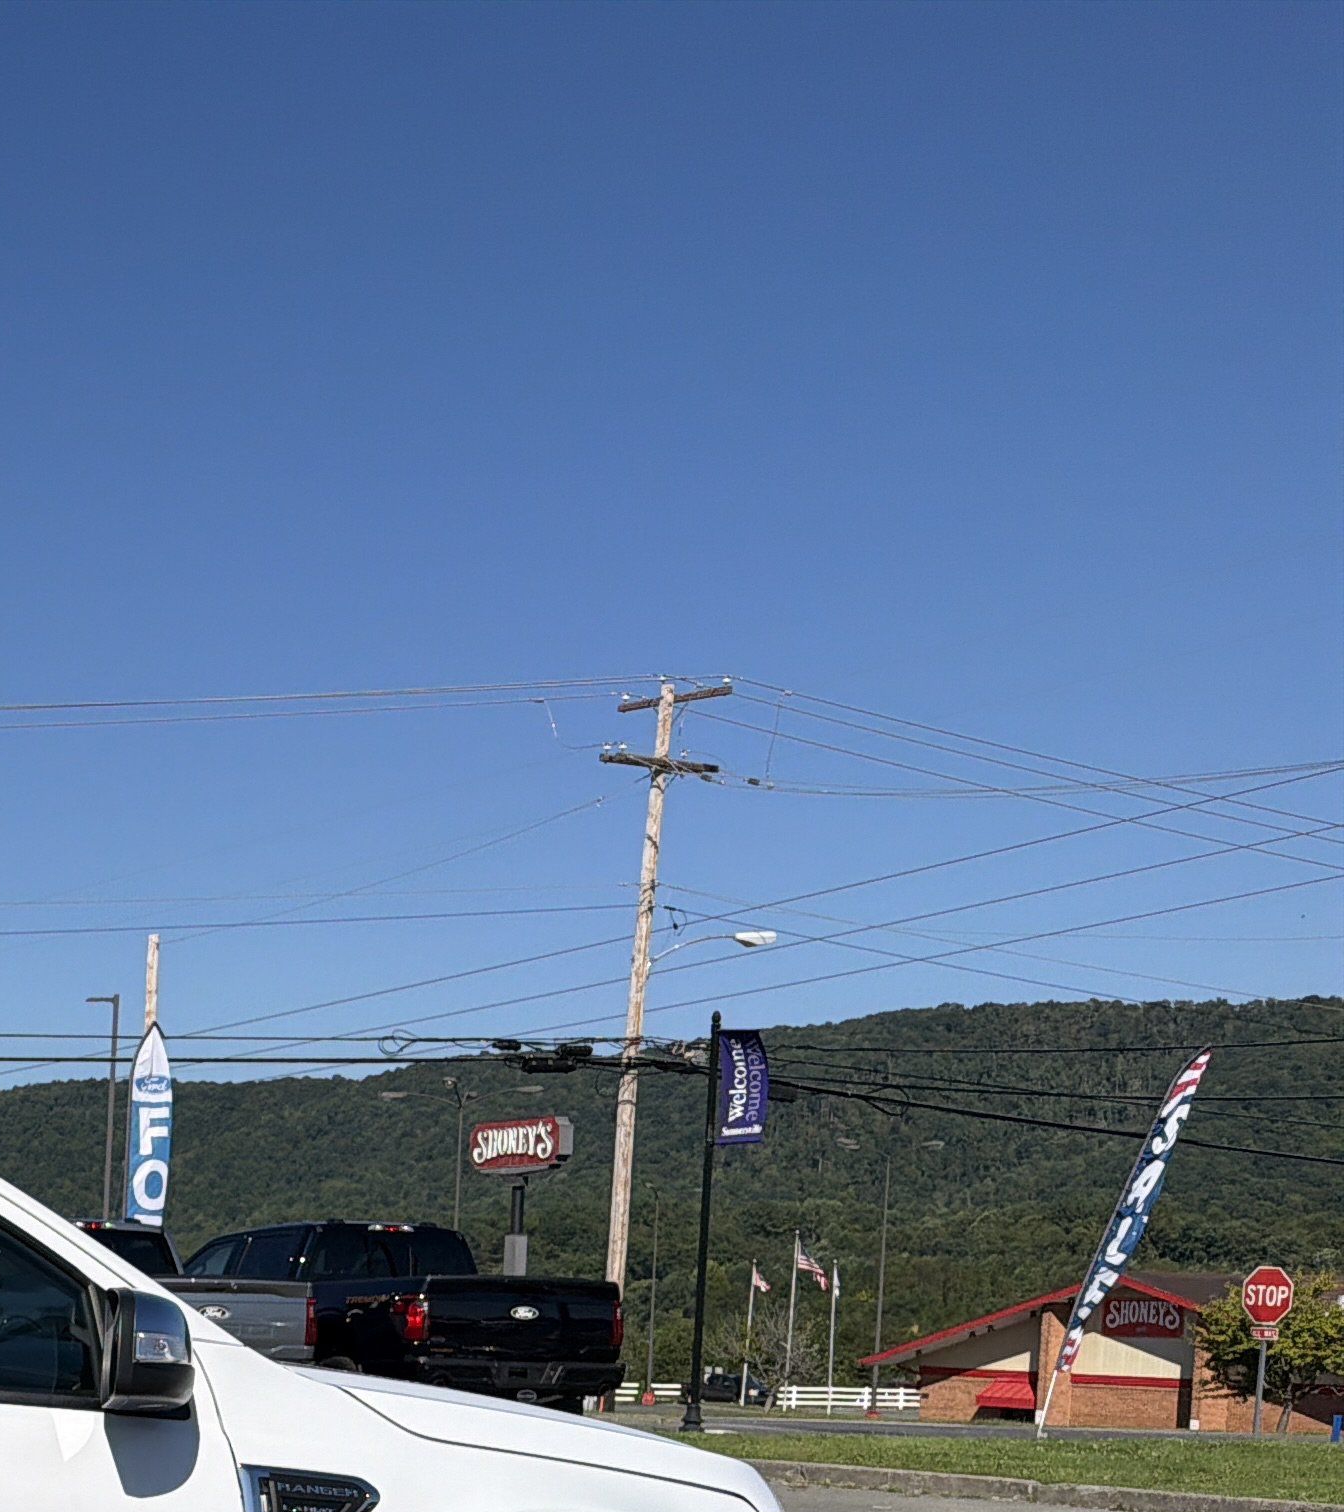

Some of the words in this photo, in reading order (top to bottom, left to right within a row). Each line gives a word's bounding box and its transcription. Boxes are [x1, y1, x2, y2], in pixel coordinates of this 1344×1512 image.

[727, 1038, 748, 1123] Welcome
[472, 1120, 553, 1163] SHONEY'S
[1245, 1284, 1289, 1307] STOP
[1105, 1300, 1181, 1330] SHONEY'S
